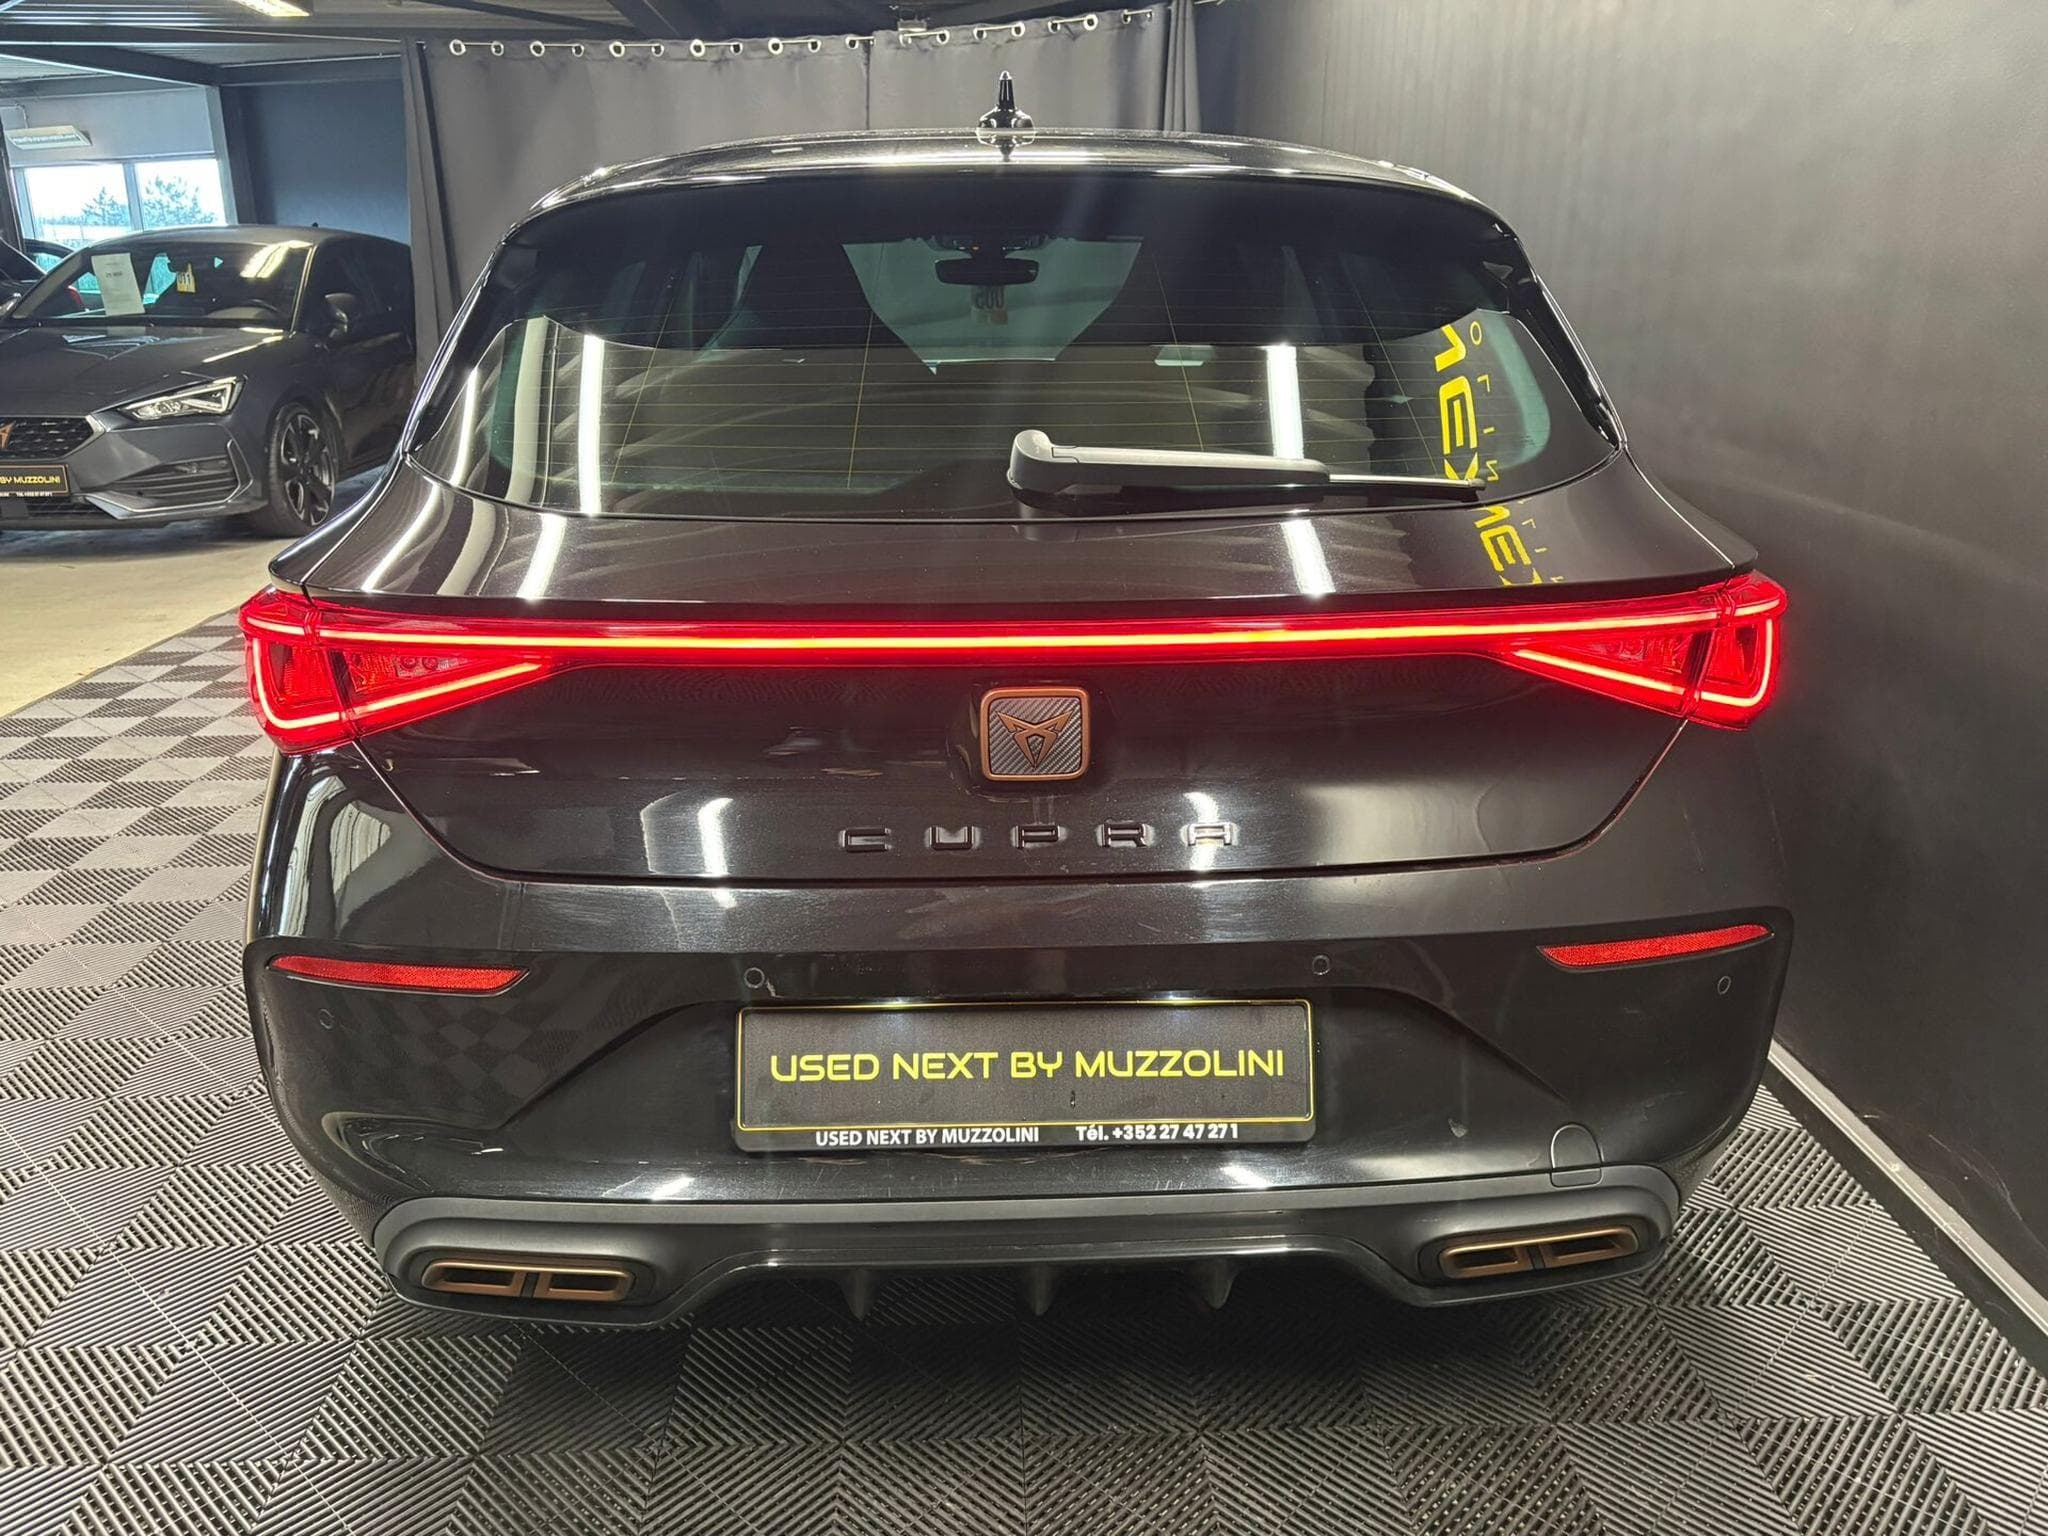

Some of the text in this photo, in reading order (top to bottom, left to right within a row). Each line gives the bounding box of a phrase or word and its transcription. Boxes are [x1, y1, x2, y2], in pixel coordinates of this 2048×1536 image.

[13, 476, 61, 484] MUZZOLINI
[841, 823, 1234, 853] CUPRA
[771, 1049, 1285, 1083] USED NEXT BY MUZZOLINI
[816, 1123, 1238, 1146] USED NEXT BY MUZZOLINI Tél. +352 27 47 271
